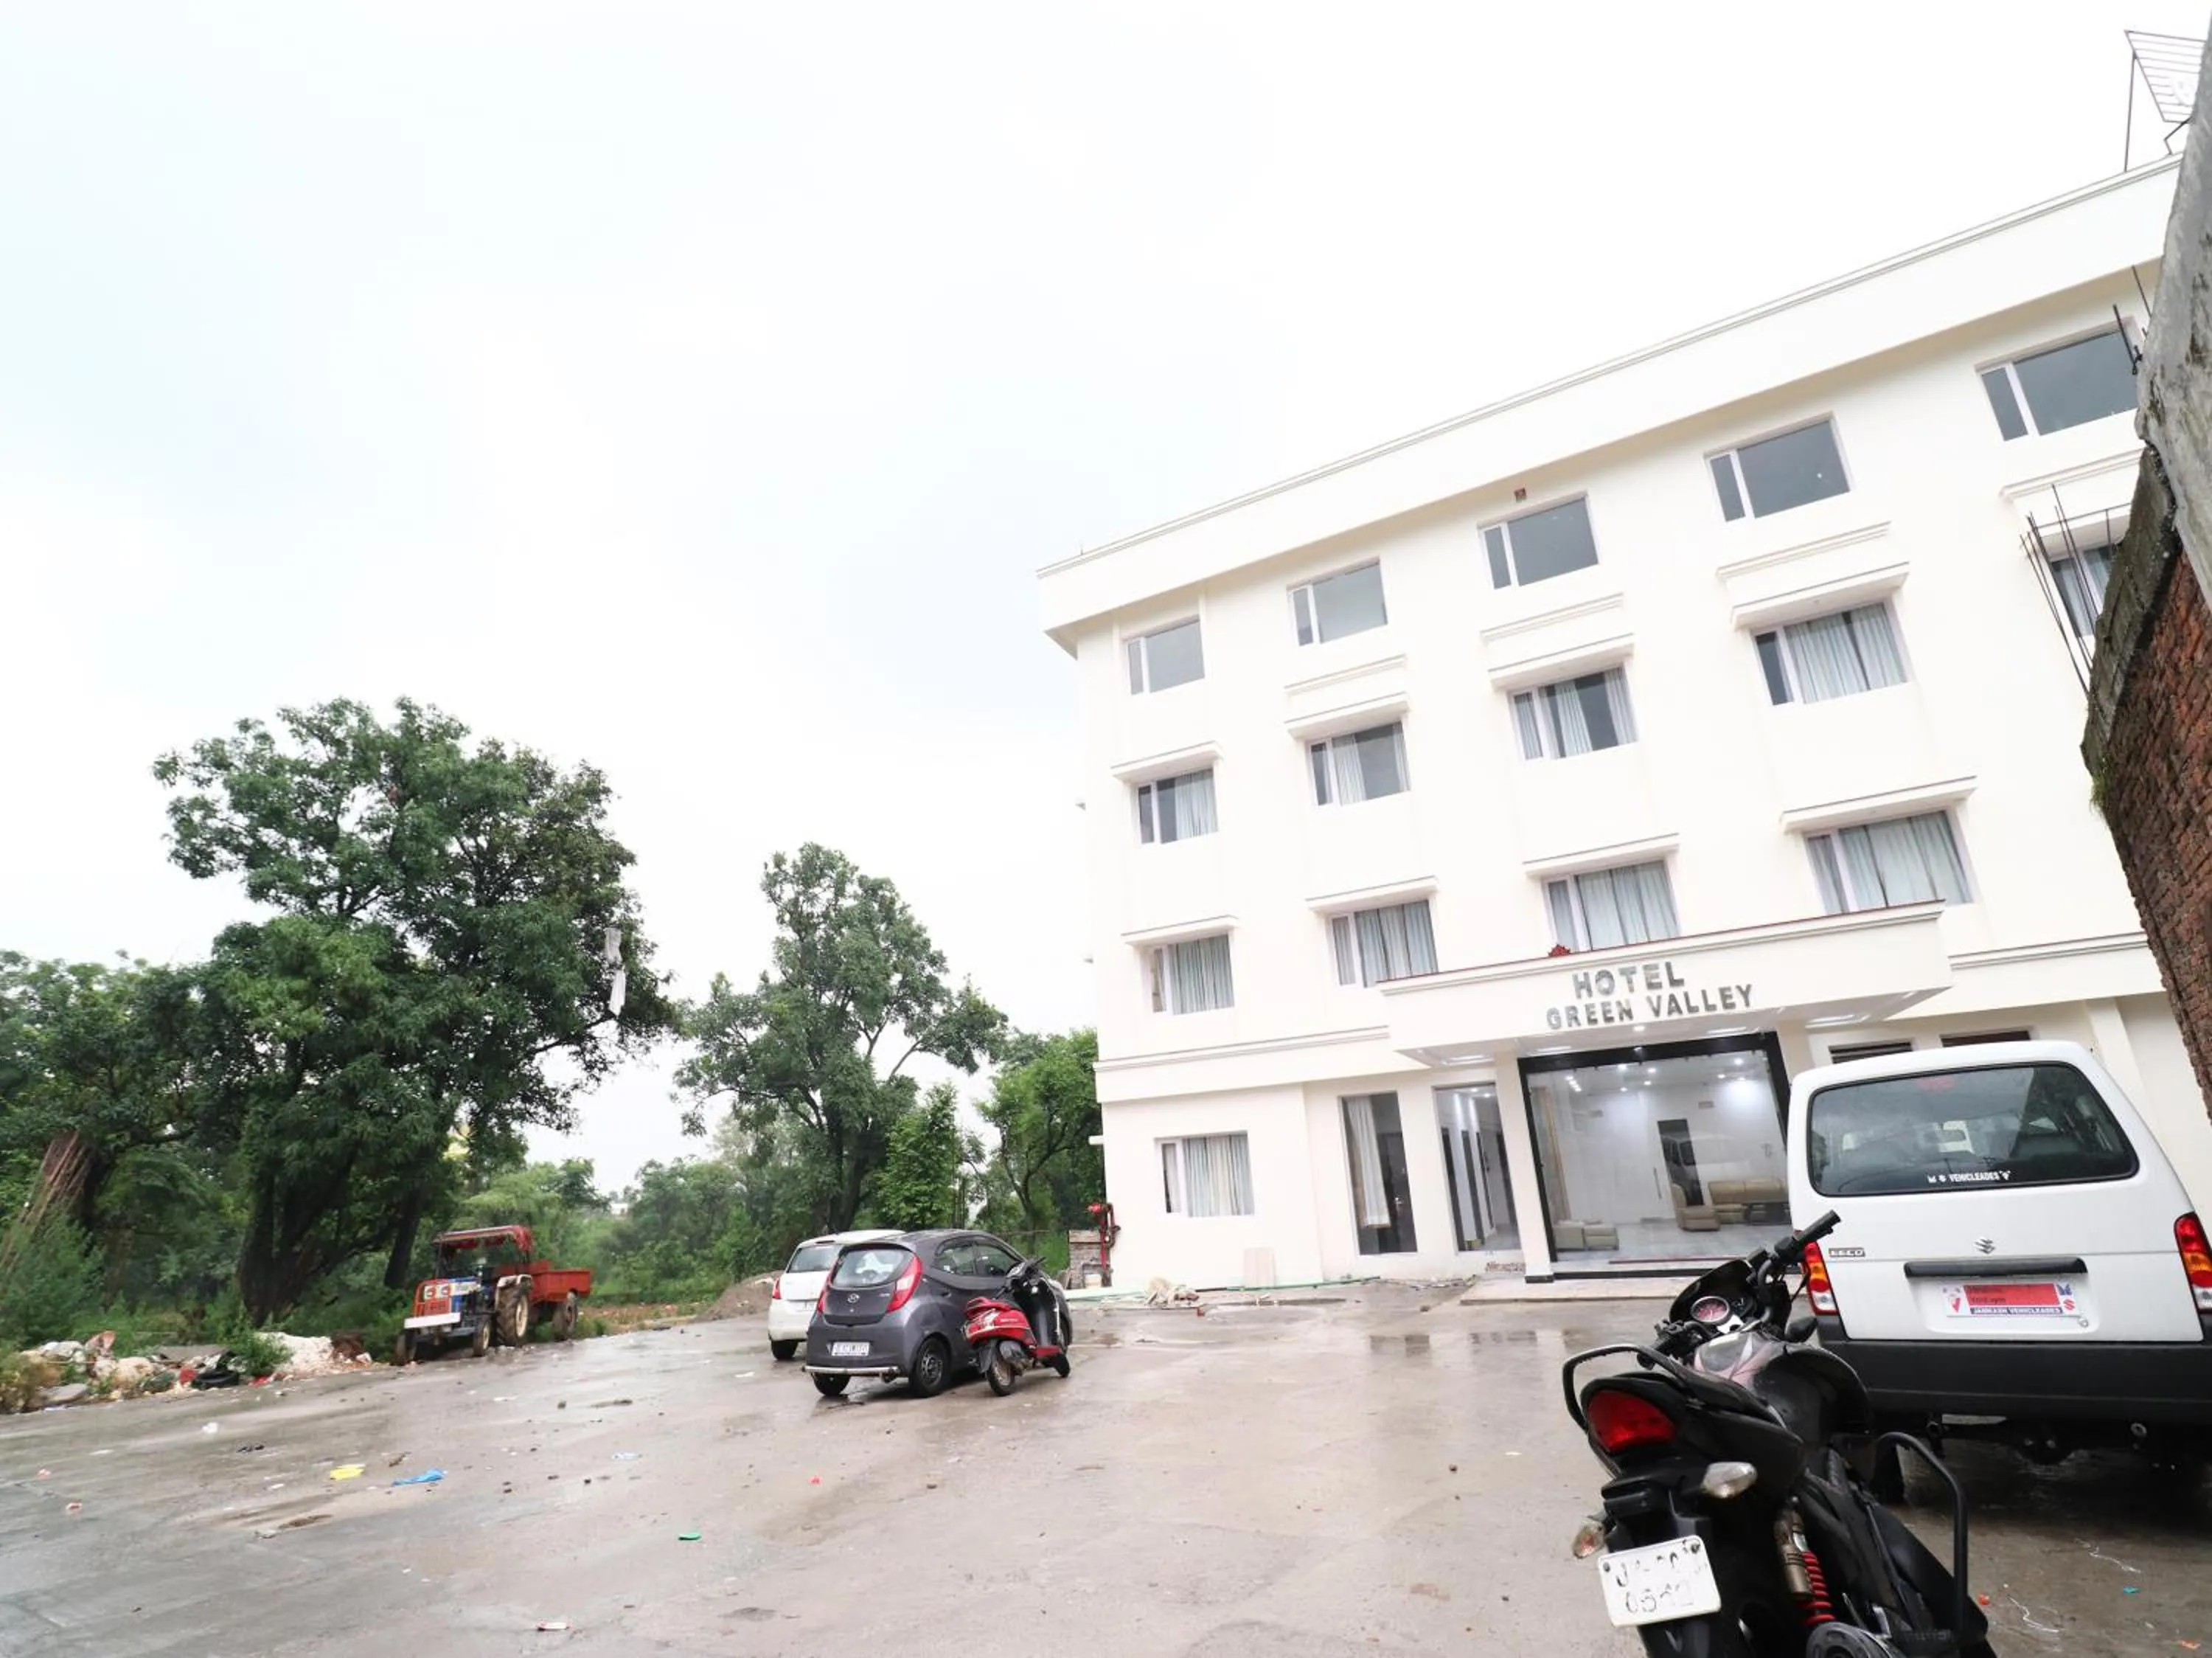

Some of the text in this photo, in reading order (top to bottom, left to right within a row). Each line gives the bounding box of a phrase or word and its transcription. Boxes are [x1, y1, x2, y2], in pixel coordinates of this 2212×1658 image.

[1572, 961, 1685, 999] HOTEL
[1547, 984, 1753, 1030] GREEN VALLEY
